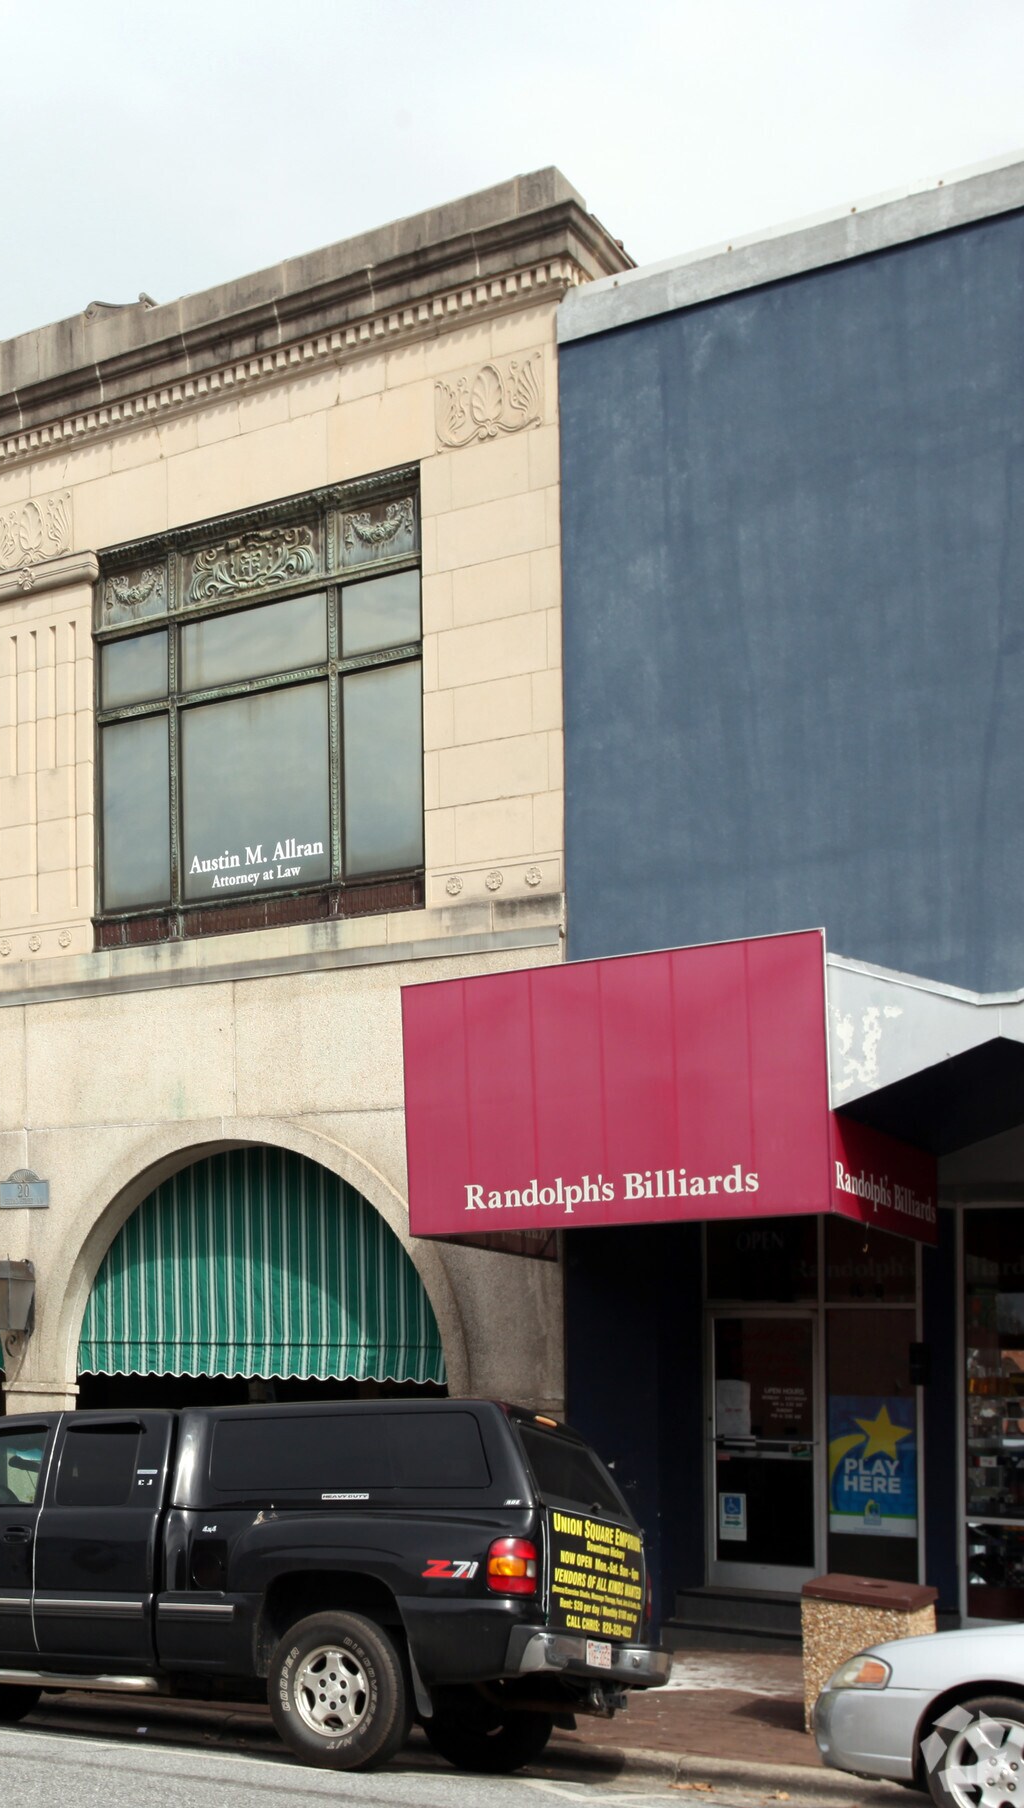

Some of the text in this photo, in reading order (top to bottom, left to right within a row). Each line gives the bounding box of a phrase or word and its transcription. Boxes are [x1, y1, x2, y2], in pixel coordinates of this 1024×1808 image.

[189, 838, 324, 874] Austin M. Allran
[212, 865, 301, 888] Attorney at Law
[17, 1183, 30, 1198] 20
[464, 1164, 760, 1213] Randolph's Billiards
[835, 1160, 937, 1224] Randolph's Billiards
[783, 1387, 805, 1395] HOURS
[844, 1458, 900, 1476] PLAY
[843, 1475, 902, 1494] HERE
[202, 1525, 218, 1533] 4x4
[553, 1512, 583, 1536] UNION
[584, 1520, 614, 1545] SQUARE
[421, 1559, 479, 1579] Z71
[560, 1550, 576, 1565] NOW
[576, 1554, 592, 1569] OPEN
[554, 1567, 587, 1587] VENDORS
[587, 1574, 596, 1589] OF
[596, 1577, 607, 1592] ALL
[607, 1579, 624, 1596] KINDS
[559, 1597, 573, 1609] Rent:
[573, 1599, 583, 1611] $20
[583, 1603, 592, 1614] per
[591, 1604, 600, 1616] day
[566, 1614, 581, 1629] CALL
[581, 1617, 600, 1632] CHRIS:
[279, 1646, 300, 1712] COOPER
[343, 1636, 378, 1735] DISCOVERER
